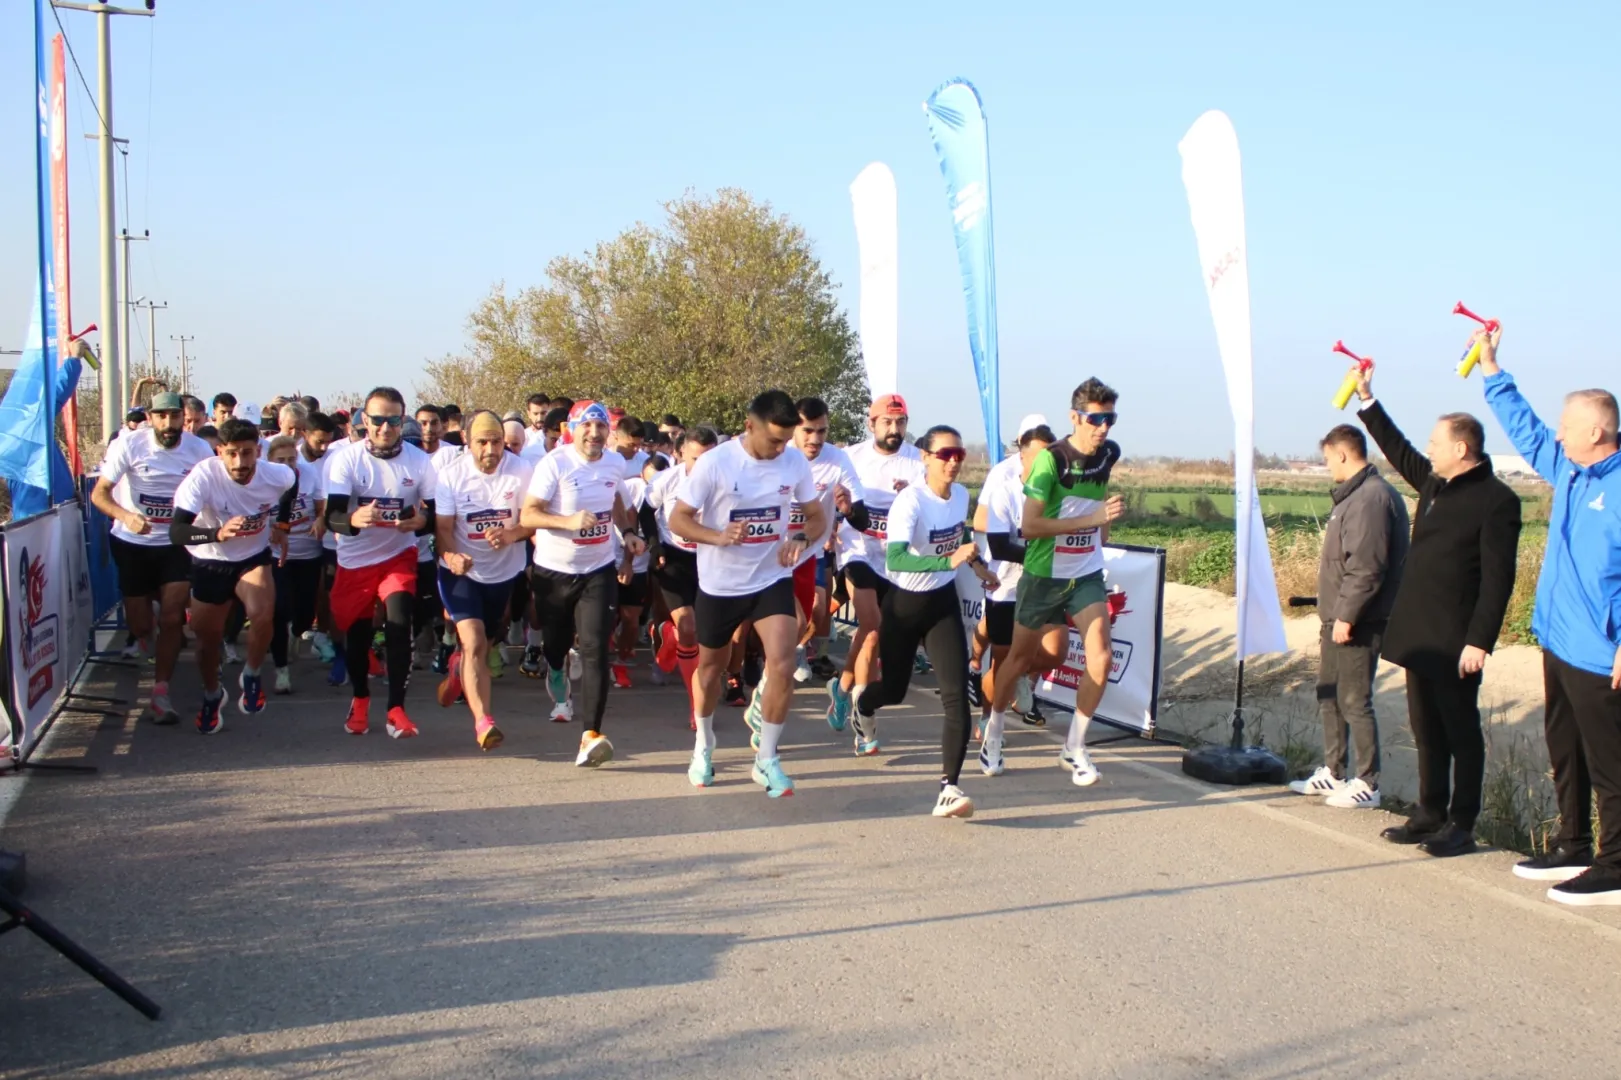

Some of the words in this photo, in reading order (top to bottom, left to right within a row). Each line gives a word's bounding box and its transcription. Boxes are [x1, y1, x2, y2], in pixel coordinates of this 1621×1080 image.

[146, 507, 173, 517] 0172
[580, 524, 608, 538] 0333
[1065, 535, 1092, 546] 0151
